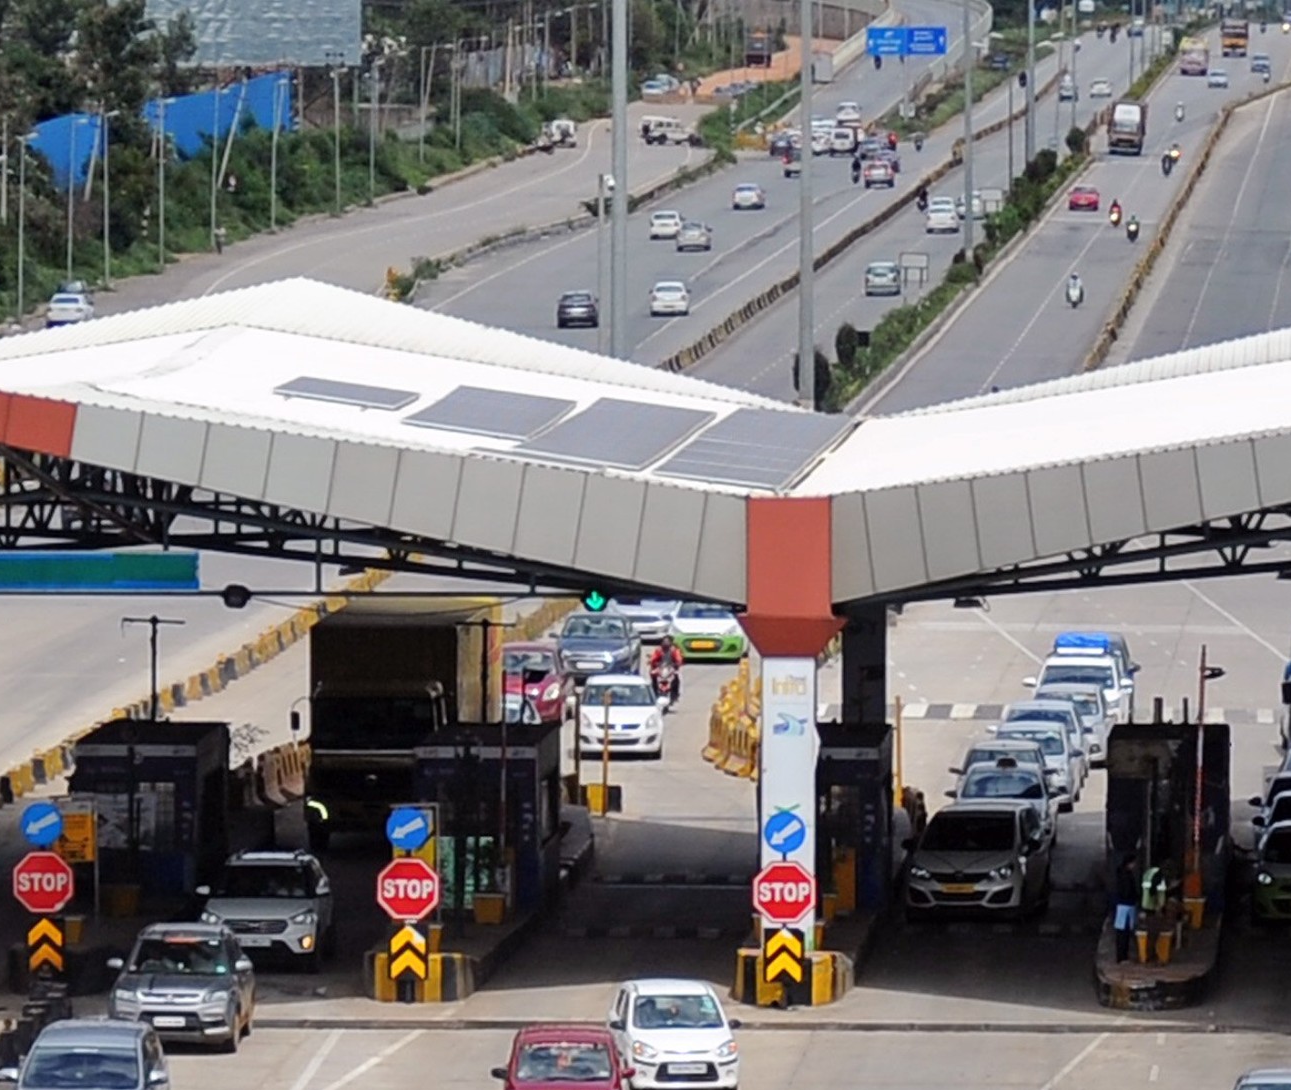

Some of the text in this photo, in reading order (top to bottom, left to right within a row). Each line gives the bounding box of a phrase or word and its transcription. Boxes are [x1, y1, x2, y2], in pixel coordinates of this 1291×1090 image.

[18, 872, 68, 892] STOP
[383, 878, 434, 899] STOP
[758, 882, 810, 903] STOP
